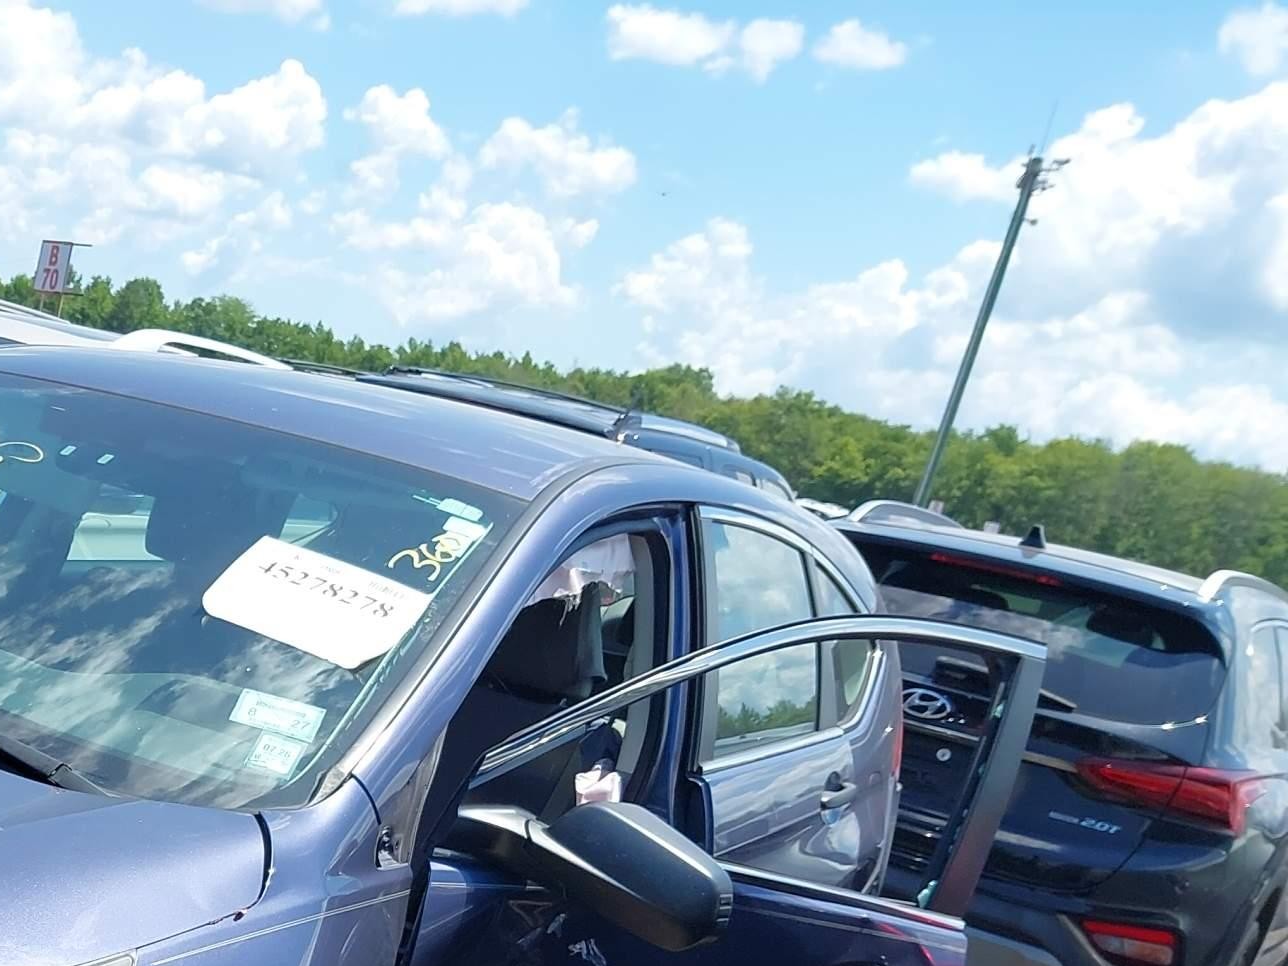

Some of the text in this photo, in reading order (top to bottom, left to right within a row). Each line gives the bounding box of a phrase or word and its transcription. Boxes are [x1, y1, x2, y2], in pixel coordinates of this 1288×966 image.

[48, 245, 60, 266] B
[41, 268, 59, 290] 70
[258, 561, 395, 618] 45278278
